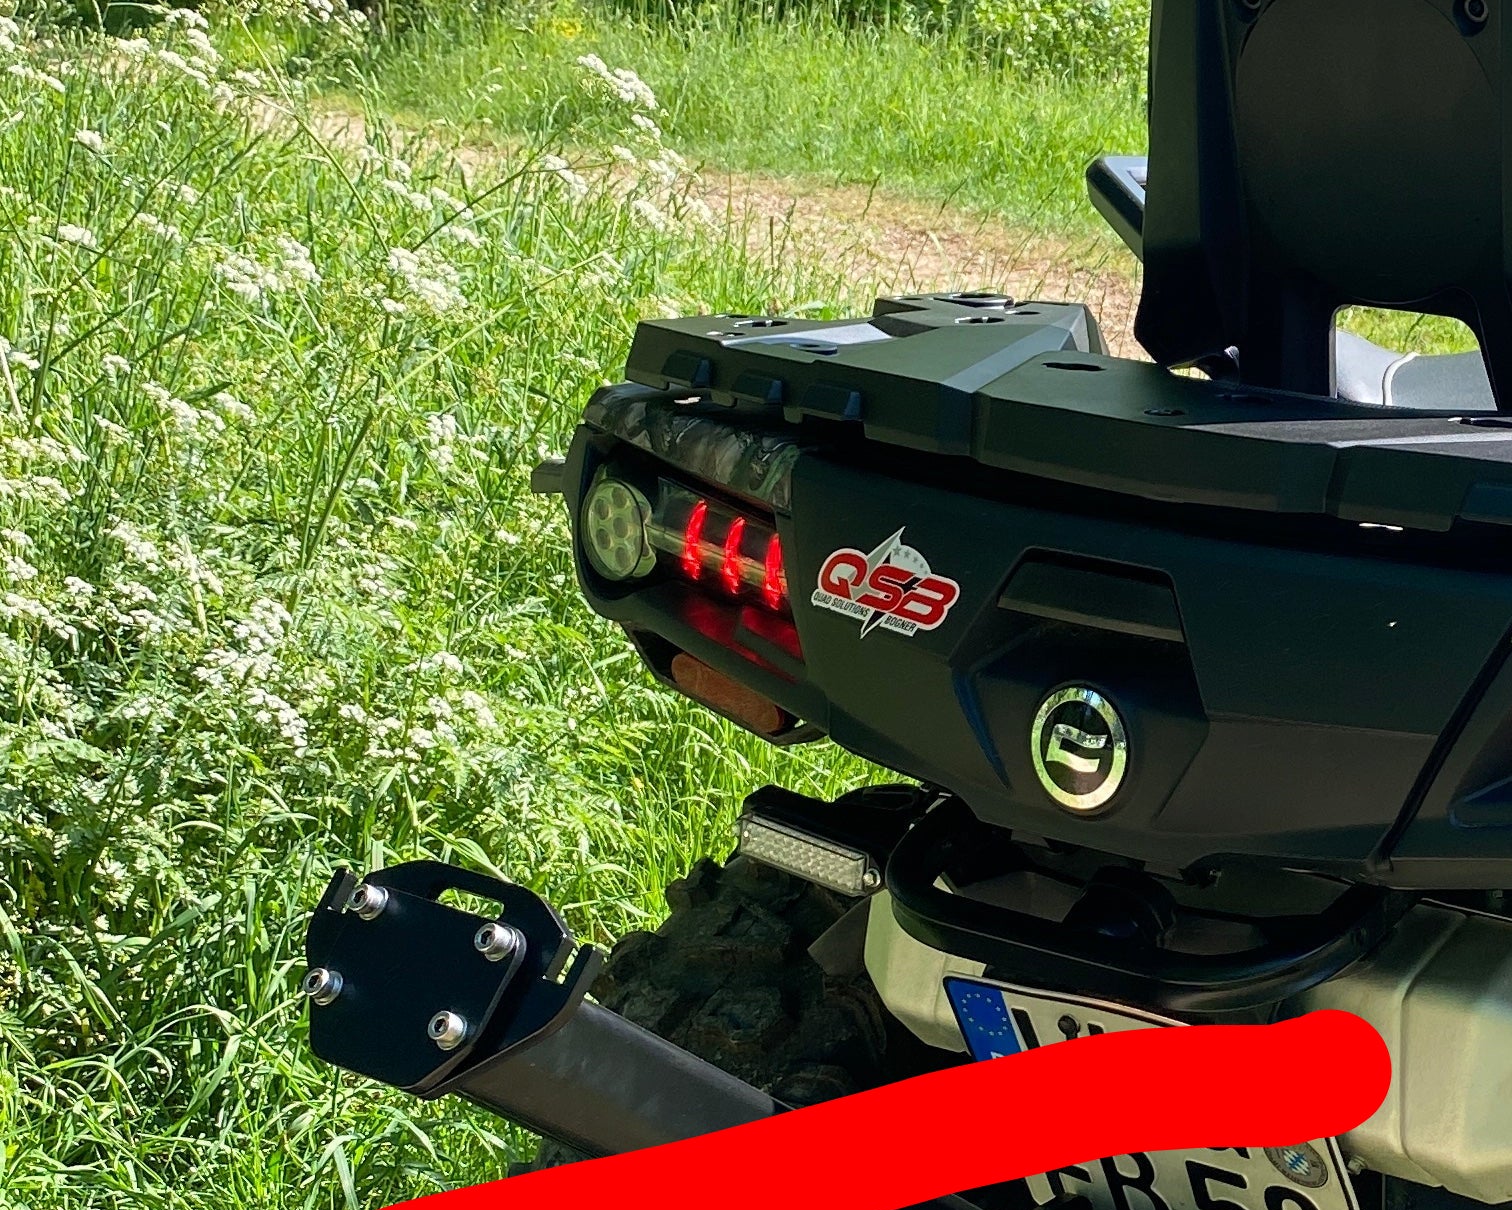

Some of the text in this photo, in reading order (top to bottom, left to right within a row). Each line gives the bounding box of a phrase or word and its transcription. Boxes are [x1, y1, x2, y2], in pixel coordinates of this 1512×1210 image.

[820, 552, 958, 627] QSB
[812, 591, 871, 618] QUAD SOLUTIONS
[884, 614, 918, 633] BOGNER
